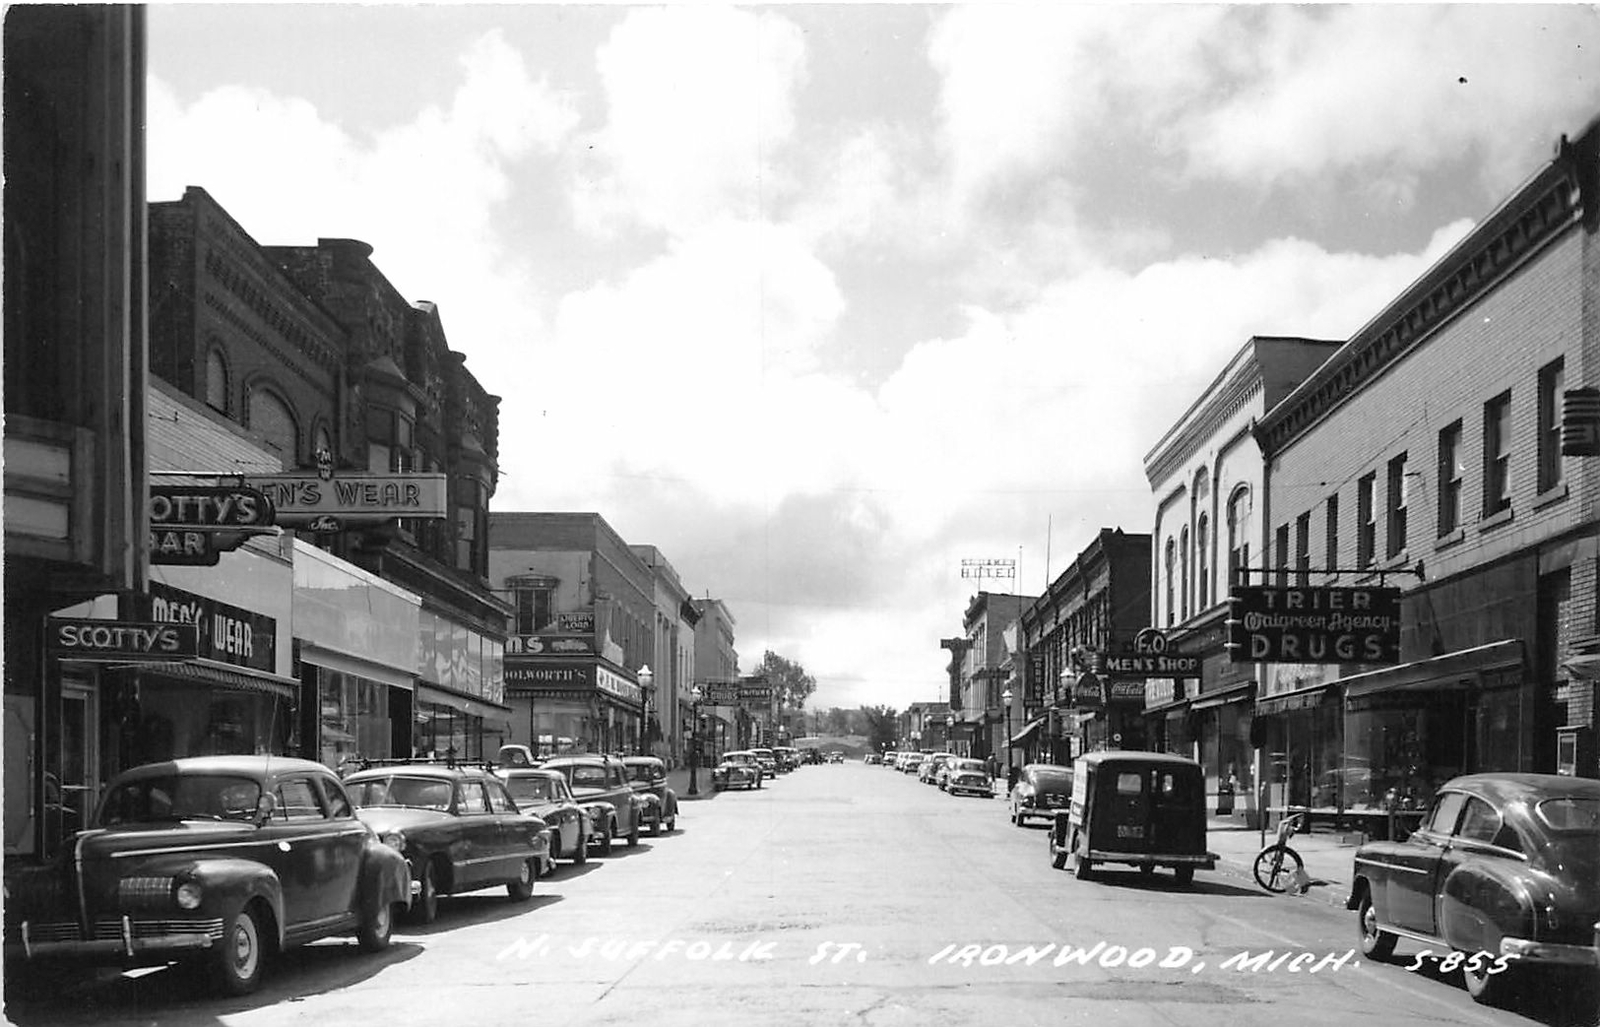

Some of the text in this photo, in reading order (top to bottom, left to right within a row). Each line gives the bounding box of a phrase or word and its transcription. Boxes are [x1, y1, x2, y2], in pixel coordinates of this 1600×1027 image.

[334, 480, 421, 507] WEAR
[149, 493, 258, 523] OTTY'S
[961, 567, 1015, 578] HOTEL
[1263, 590, 1371, 609] TRIER
[1243, 611, 1390, 632] Walgreen Agency
[59, 625, 180, 652] SCOTTY'S
[214, 612, 253, 658] WEAR
[1251, 634, 1382, 659] DRUGS
[505, 669, 587, 680] OLWORTH'S
[1106, 655, 1197, 671] MEN'S SHOP
